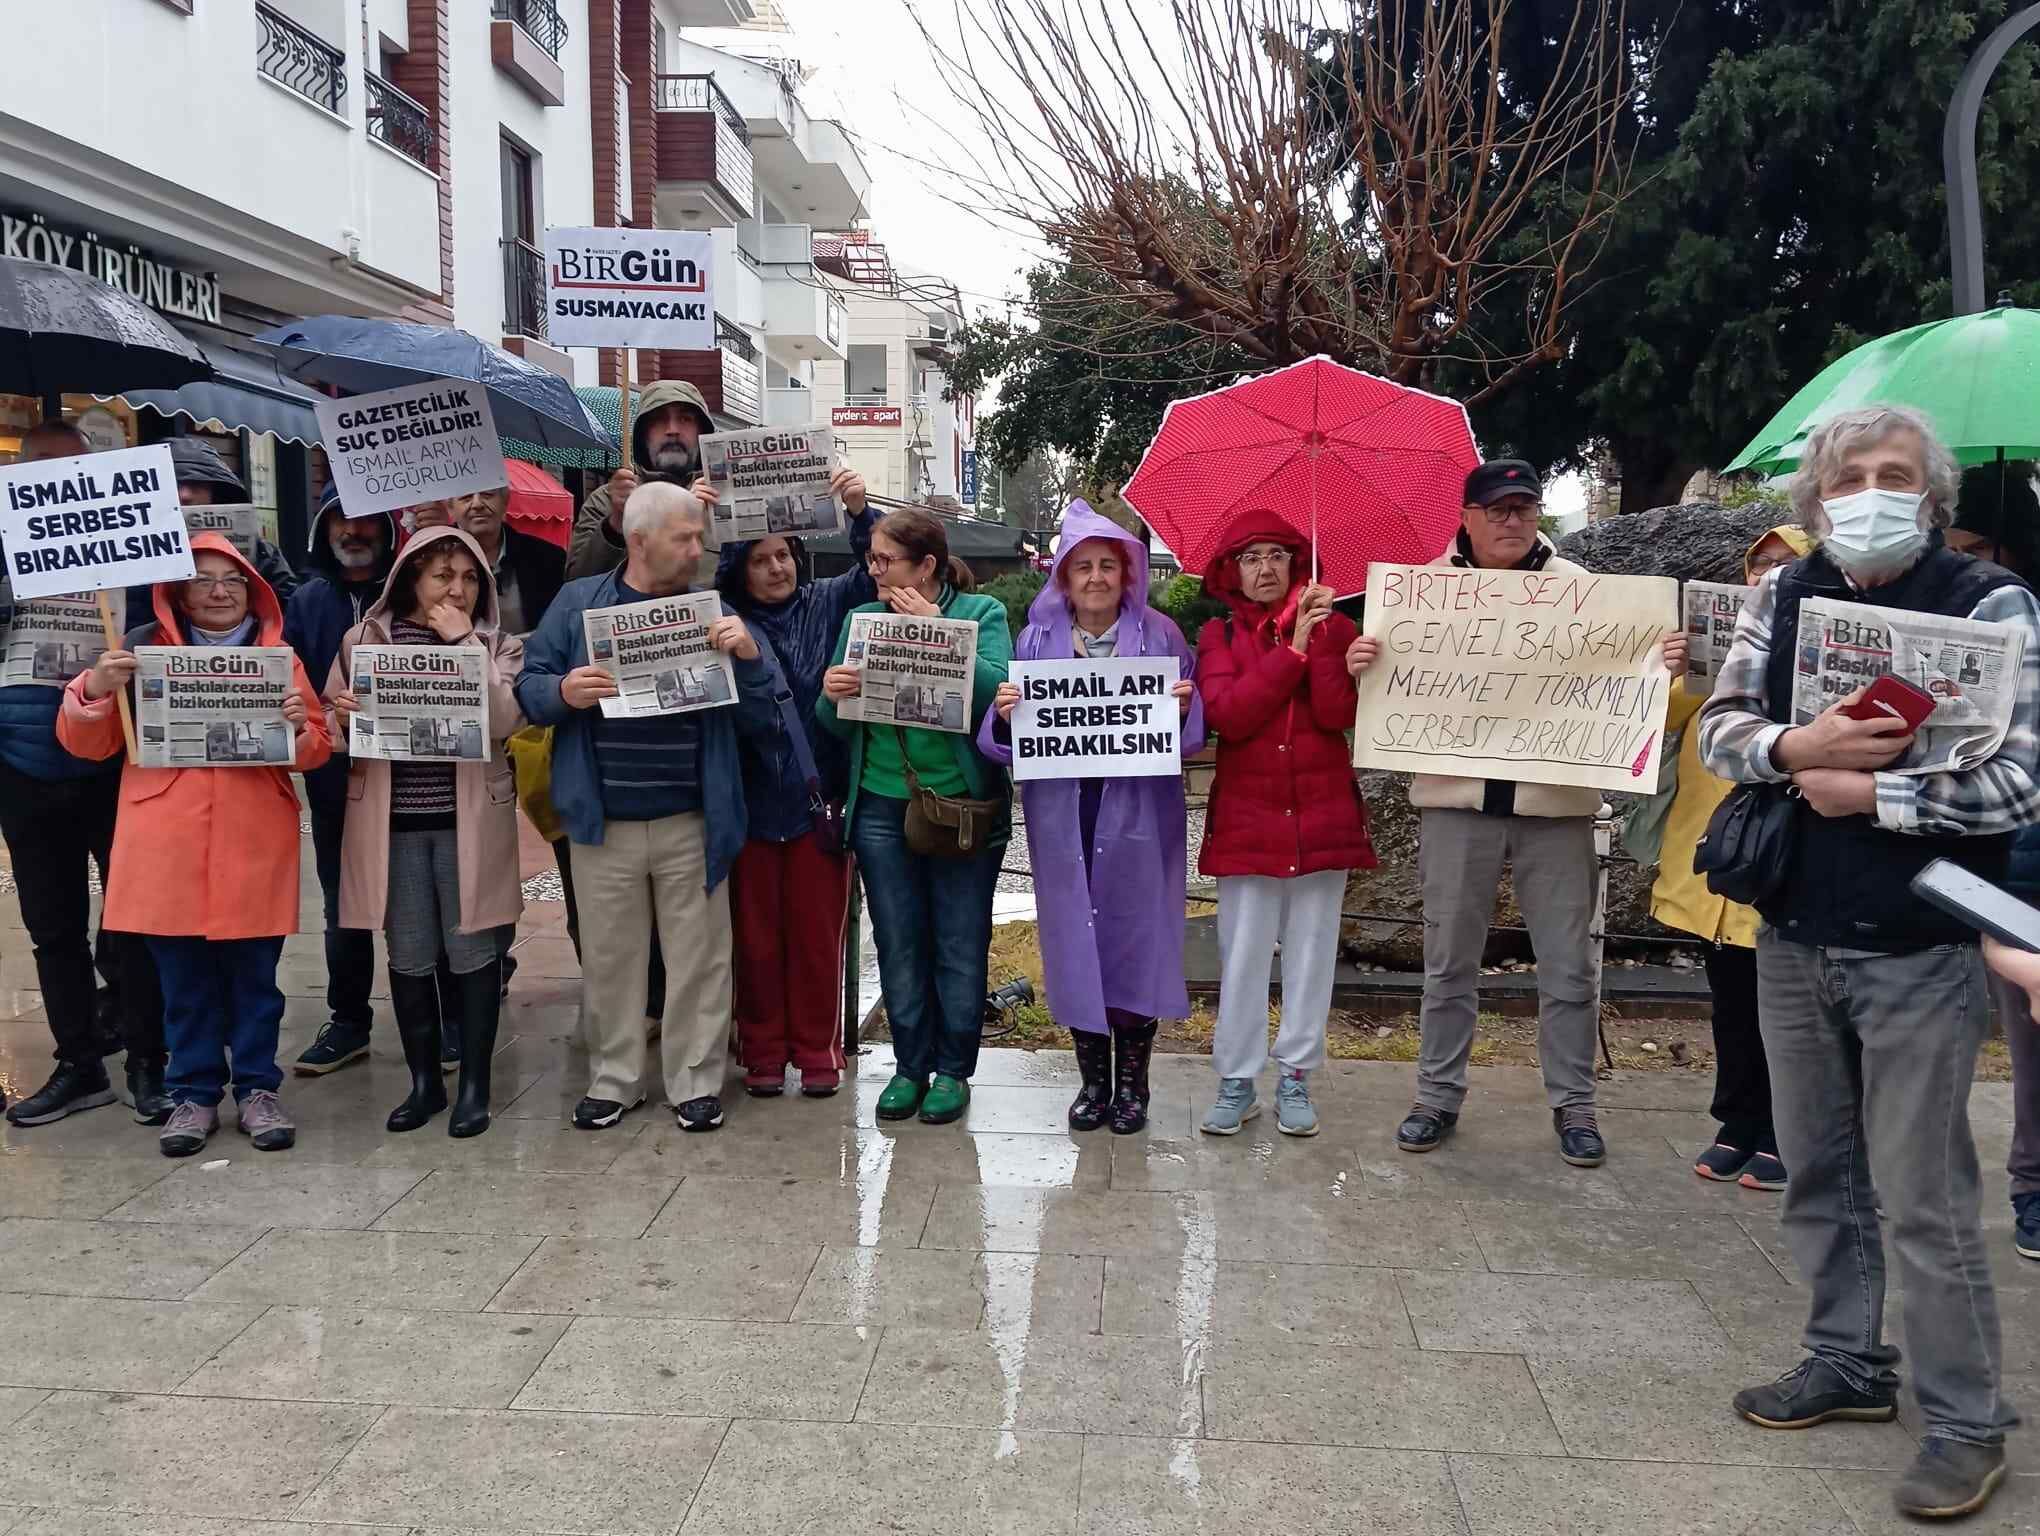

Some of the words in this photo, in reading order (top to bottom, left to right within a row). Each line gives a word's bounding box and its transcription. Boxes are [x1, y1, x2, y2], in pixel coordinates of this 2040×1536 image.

[1, 213, 75, 267] KÖY
[80, 231, 222, 325] ÜRÜNLERİ
[555, 298, 706, 321] SUSMAYACAK!
[337, 389, 471, 429] GAZETECİLİK
[873, 409, 900, 423] apart
[336, 430, 380, 453] SUÇ
[382, 410, 483, 445] DEĞİLDİR!
[347, 449, 414, 476] İSMAİL
[420, 435, 483, 462] ARI'YA
[732, 459, 784, 475] Baskılar
[784, 455, 829, 470] cezalar
[7, 472, 105, 511] İSMAİL
[111, 467, 160, 497] ARI
[365, 457, 479, 495] ÖZGÜRLÜK!
[733, 474, 756, 488] bizi
[756, 470, 831, 486] korkutamaz
[27, 502, 152, 541] SERBEST
[14, 530, 183, 576] BIRAKILSIN!
[29, 619, 106, 634] korkutama
[617, 634, 670, 651] Baskılar
[671, 625, 710, 642] cezala
[619, 651, 644, 666] bizi
[644, 641, 718, 663] korkutama
[868, 643, 920, 660] Baskılar
[921, 649, 968, 665] cezalar
[1388, 617, 1506, 657] GENEL
[1513, 619, 1664, 667] BAŞKANI
[867, 658, 891, 672] bizi
[891, 662, 966, 680] korkutamaz
[169, 680, 229, 694] Baskılar
[231, 681, 286, 694] cezalar
[376, 678, 432, 691] Baskılar
[432, 680, 480, 692] cezalar
[1023, 672, 1114, 701] İSMAİL
[1119, 674, 1165, 697] ARI
[1386, 664, 1528, 703] MEHMET
[1535, 672, 1660, 723] TÜRKMEN
[169, 697, 199, 709] bizi
[377, 692, 402, 705] bizi
[401, 692, 481, 707] korkutamaz
[1036, 703, 1153, 729] SERBEST
[1018, 732, 1173, 758] BIRAKILSIN!
[1372, 712, 1510, 752] SERBEST
